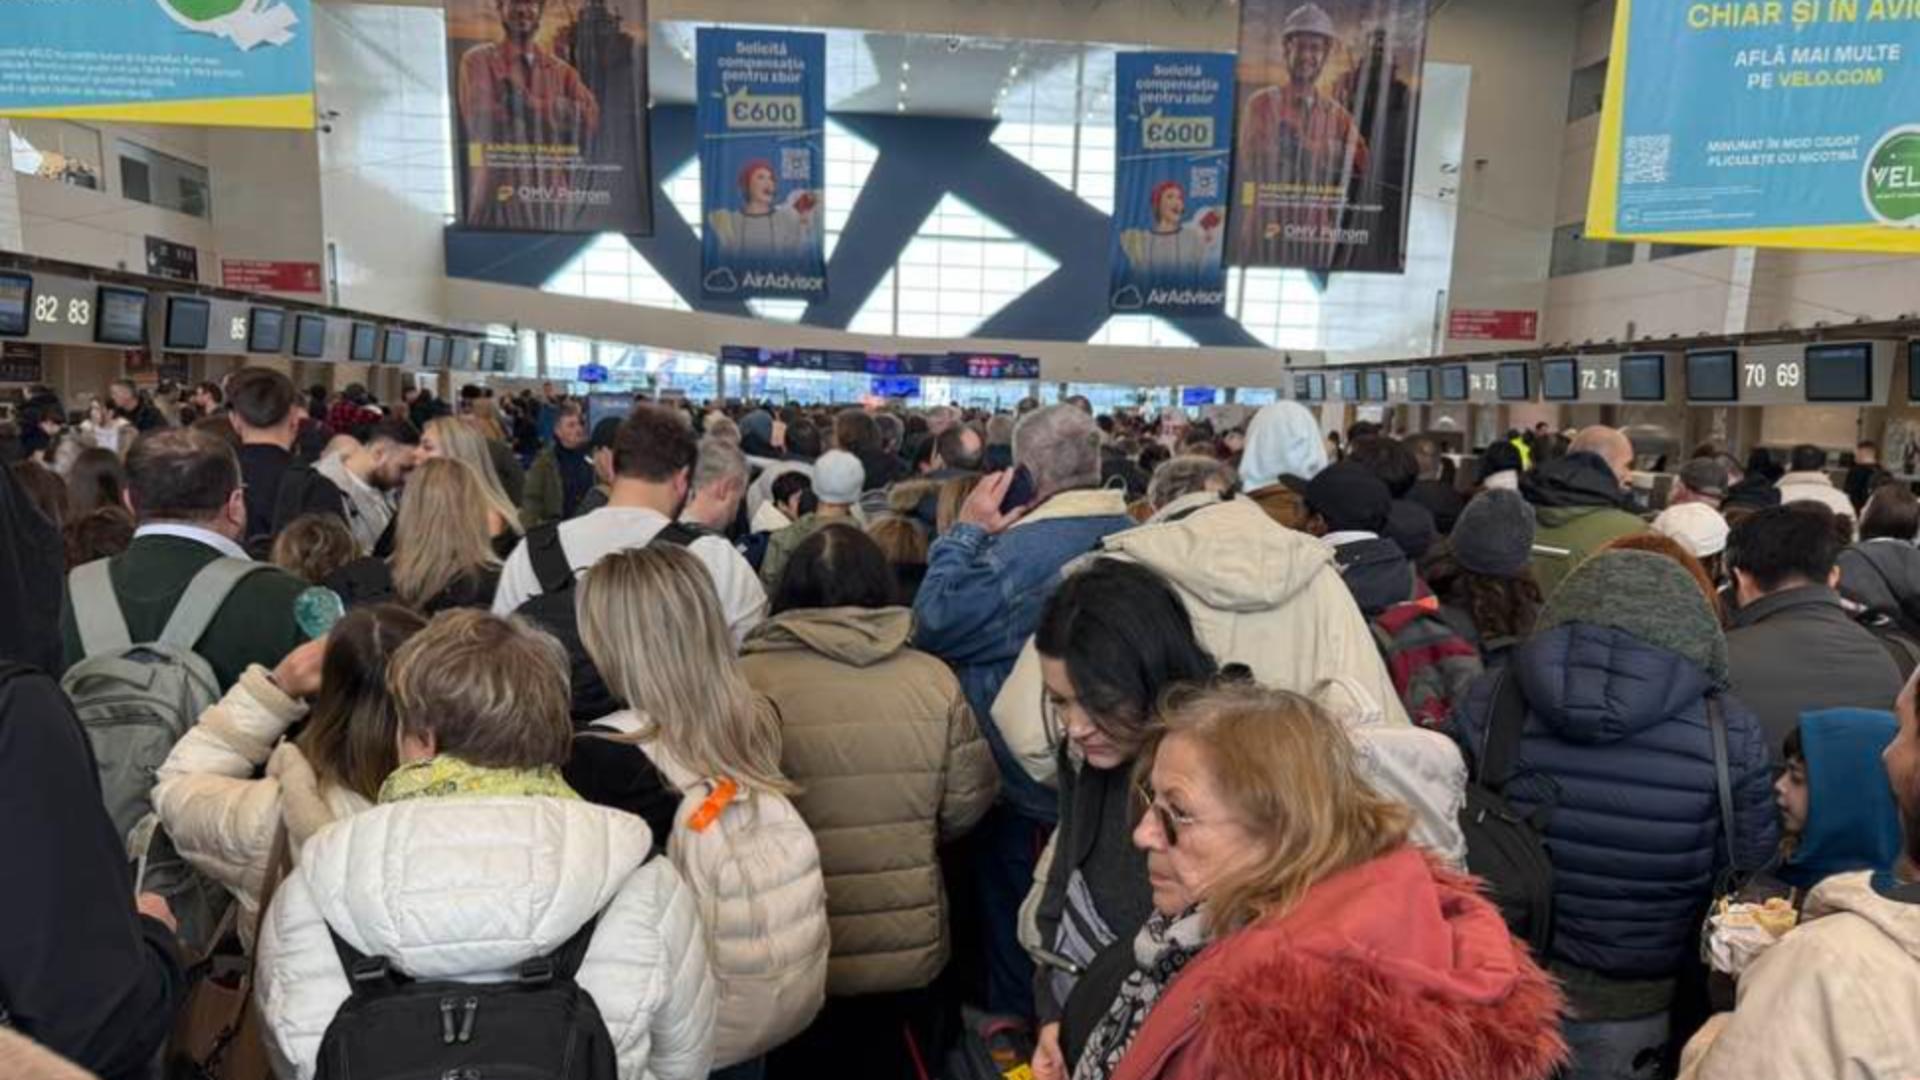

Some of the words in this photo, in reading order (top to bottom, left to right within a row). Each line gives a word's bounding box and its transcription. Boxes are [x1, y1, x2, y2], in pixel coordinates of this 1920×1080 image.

[1688, 2, 1784, 29] CHIAR
[1866, 0, 1920, 22] AVI
[736, 40, 788, 55] Solicită
[1734, 44, 1786, 68] AFLĂ
[1791, 46, 1829, 64] MAI
[1833, 43, 1903, 62] MULTE
[718, 56, 805, 71] compensația
[1153, 64, 1202, 77] Solicită
[722, 70, 768, 85] pentru
[771, 70, 802, 84] zbor
[1136, 77, 1219, 93] compensația
[1747, 72, 1774, 89] PE
[1778, 68, 1884, 88] VELO.COM
[1140, 91, 1182, 106] pentru
[1184, 91, 1216, 104] zbor
[733, 101, 797, 122] €600
[1147, 124, 1208, 143] €600
[1707, 138, 1763, 152] MINUNAT
[1783, 136, 1812, 149] MOD
[1814, 135, 1860, 148] CIUDAT
[1777, 153, 1796, 164] CU
[1799, 148, 1858, 164] NICOTINĂ
[519, 187, 554, 201] OMV
[557, 187, 612, 202] Petrom
[1284, 223, 1317, 238] OMV
[1321, 226, 1369, 242] Petrom
[742, 270, 824, 290] AirAdvisor
[1147, 288, 1223, 306] AirAdvisor
[35, 296, 58, 322] 82
[67, 298, 90, 325] 83
[230, 317, 246, 340] 85
[1581, 369, 1597, 389] 72
[1603, 369, 1619, 388] 71
[1743, 363, 1766, 387] 70
[1775, 362, 1800, 387] 69
